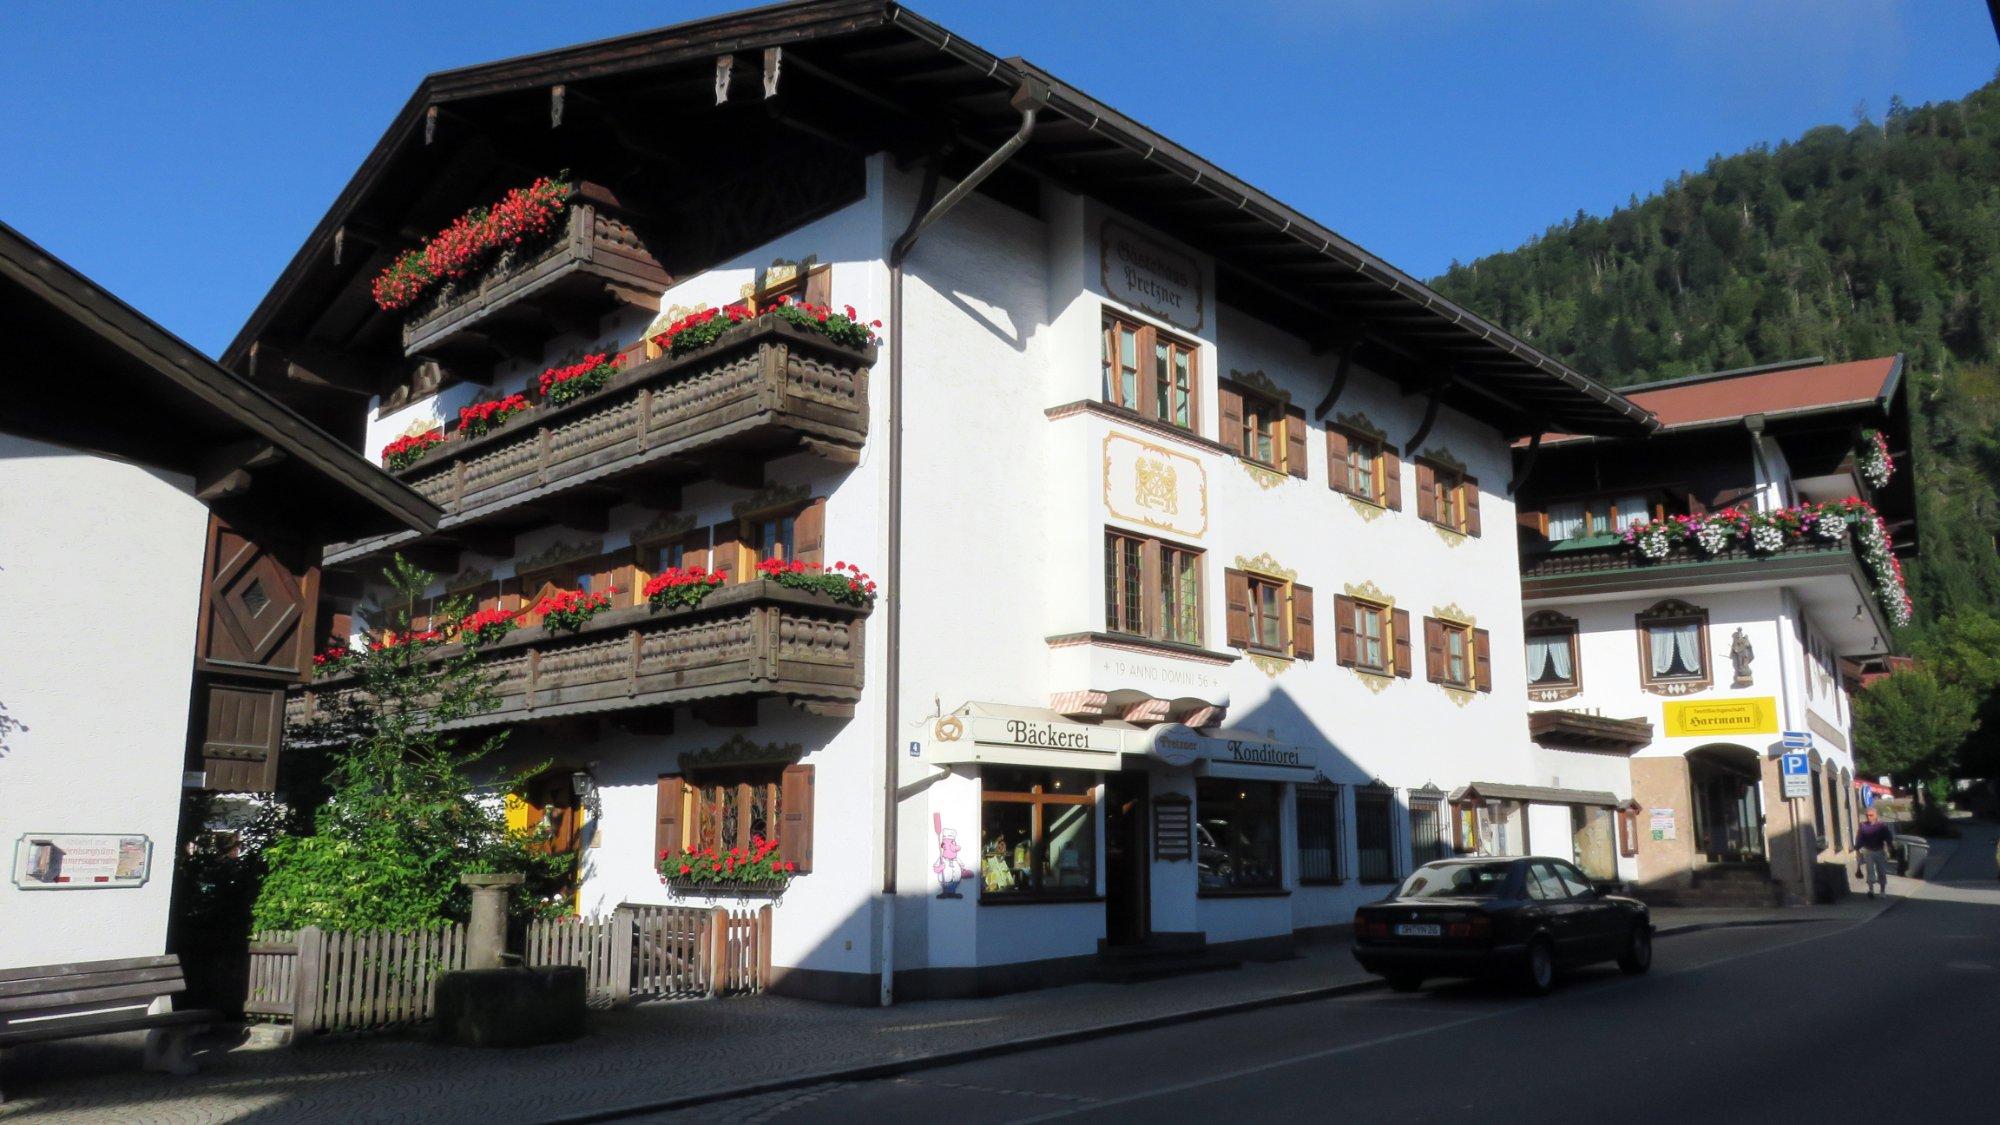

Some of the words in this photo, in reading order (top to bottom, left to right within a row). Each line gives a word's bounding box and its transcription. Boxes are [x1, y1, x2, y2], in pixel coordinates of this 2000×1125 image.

[1124, 265, 1182, 308] Pretzner
[1115, 662, 1126, 675] 19
[1130, 664, 1157, 680] ANNO
[1161, 668, 1194, 685] DOMINI
[1197, 673, 1209, 688] 56
[1007, 719, 1089, 748] Bäckerei
[1690, 716, 1751, 727] Hartmann
[1227, 740, 1299, 765] Konditorei
[1789, 756, 1802, 774] P
